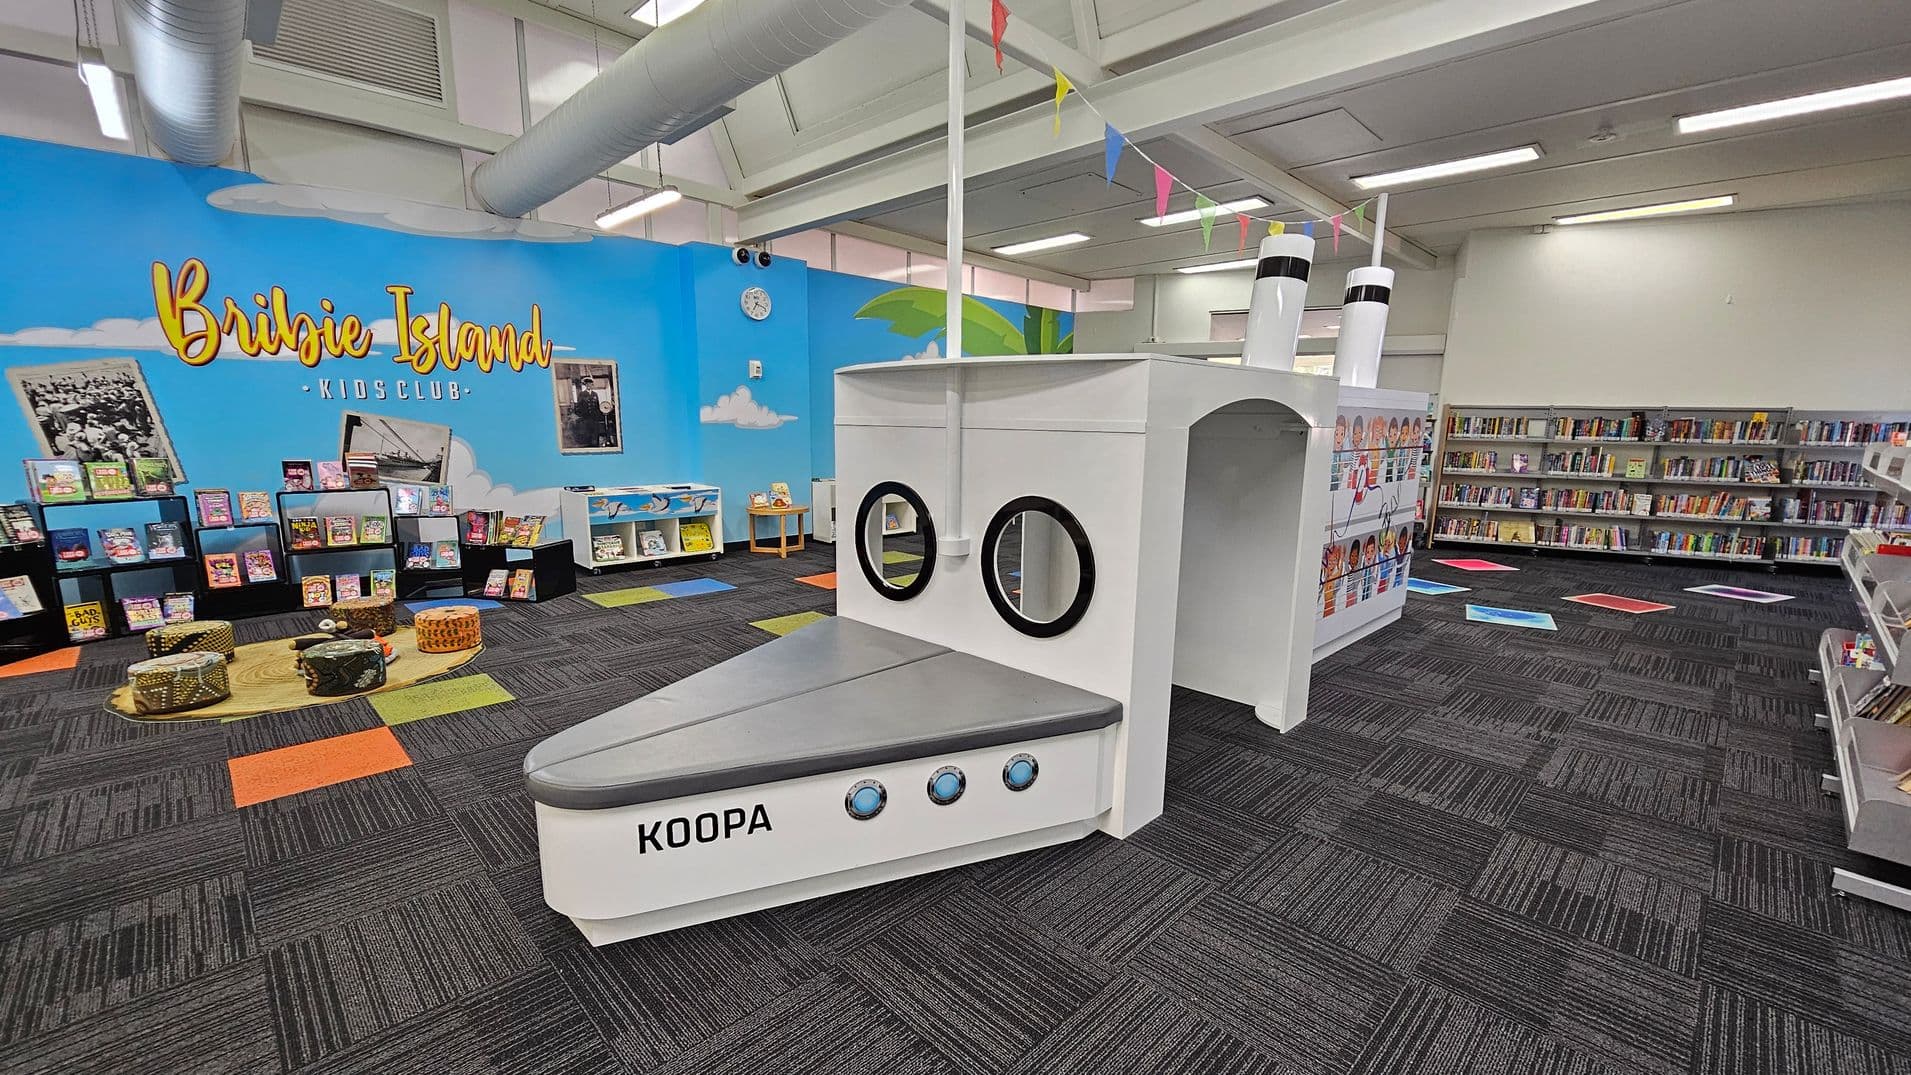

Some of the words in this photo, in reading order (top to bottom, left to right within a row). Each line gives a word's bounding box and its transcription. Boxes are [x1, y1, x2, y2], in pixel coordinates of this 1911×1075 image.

[151, 257, 373, 367] Bribie
[385, 284, 552, 375] Island
[319, 378, 387, 400] KIDS
[396, 379, 461, 401] CLUB
[71, 616, 100, 627] GUYS
[74, 608, 97, 619] BAD
[637, 804, 773, 855] KOOPA
